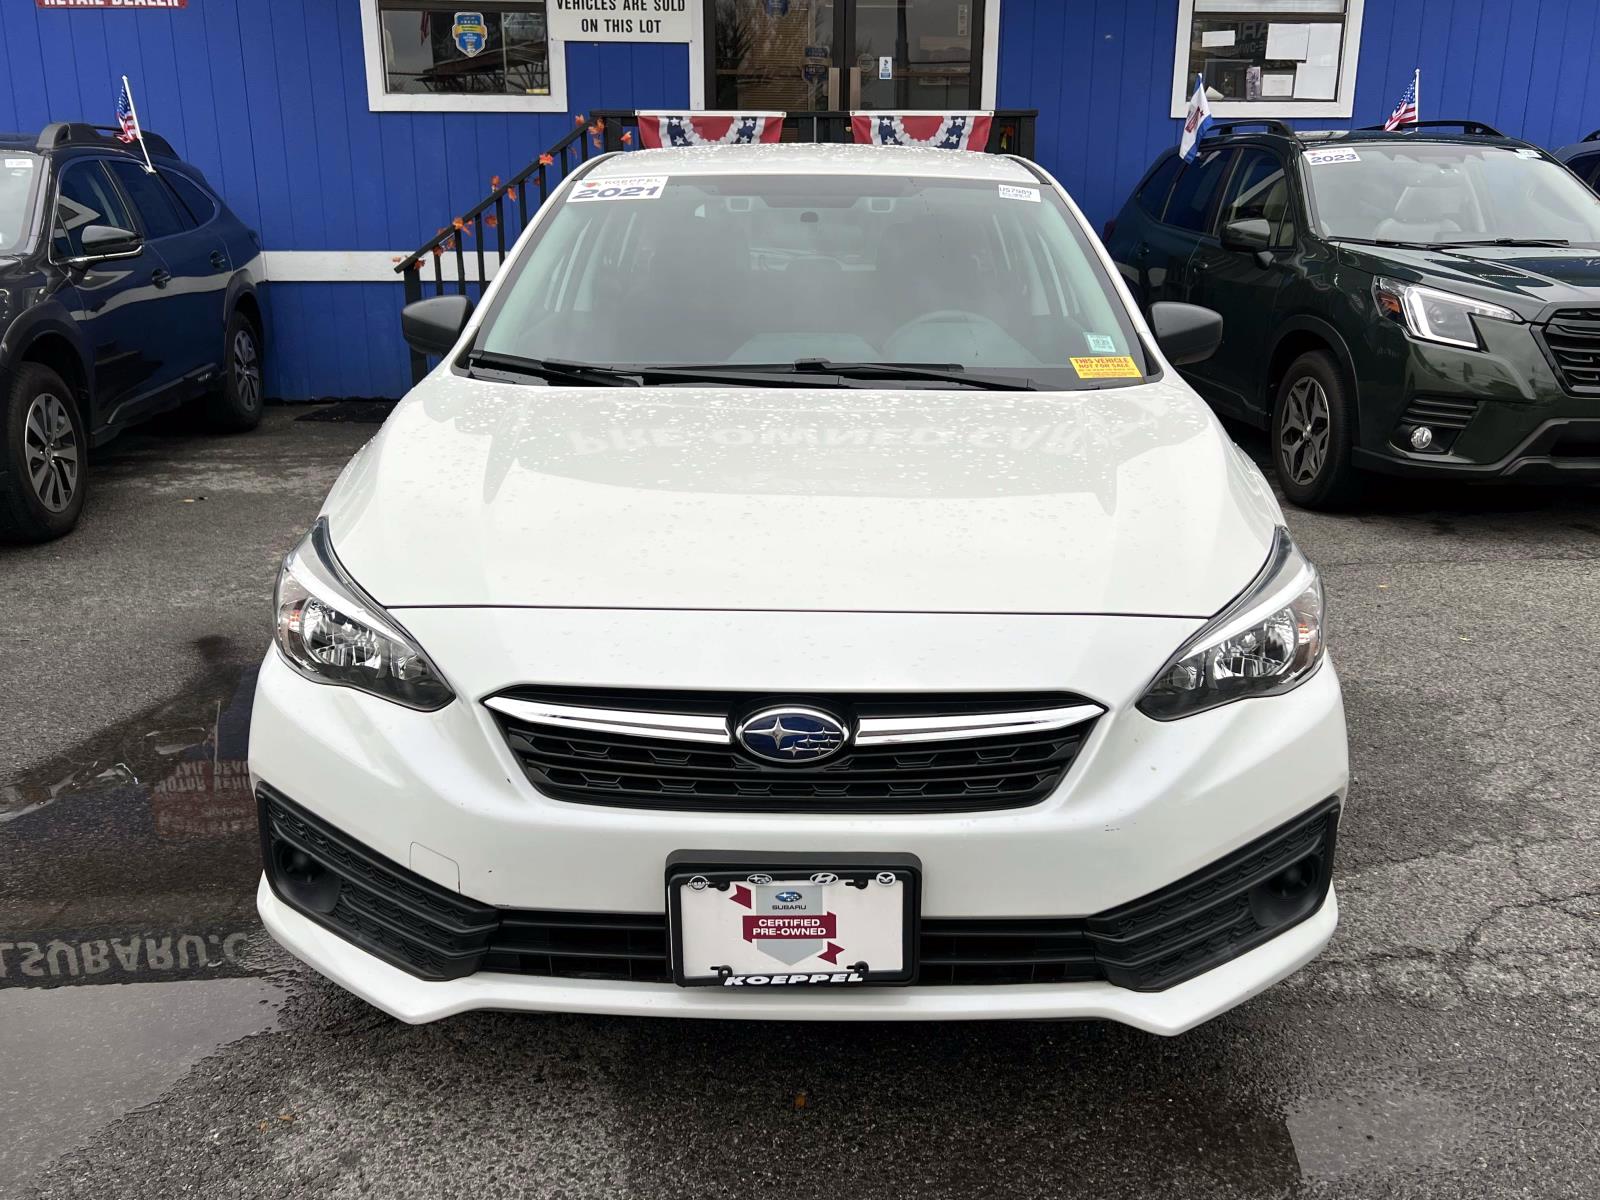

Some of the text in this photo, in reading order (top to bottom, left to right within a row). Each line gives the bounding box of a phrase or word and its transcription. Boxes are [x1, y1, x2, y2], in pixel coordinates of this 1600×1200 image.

[556, 0, 685, 12] VEHICLES ARE SOLD
[581, 19, 661, 33] ON THIS LOT
[1311, 154, 1357, 163] 2023
[572, 186, 659, 199] 2021
[758, 919, 820, 927] CERTIFIED
[753, 928, 826, 936] PRE-OWNED
[724, 973, 863, 986] KOEPPEL
